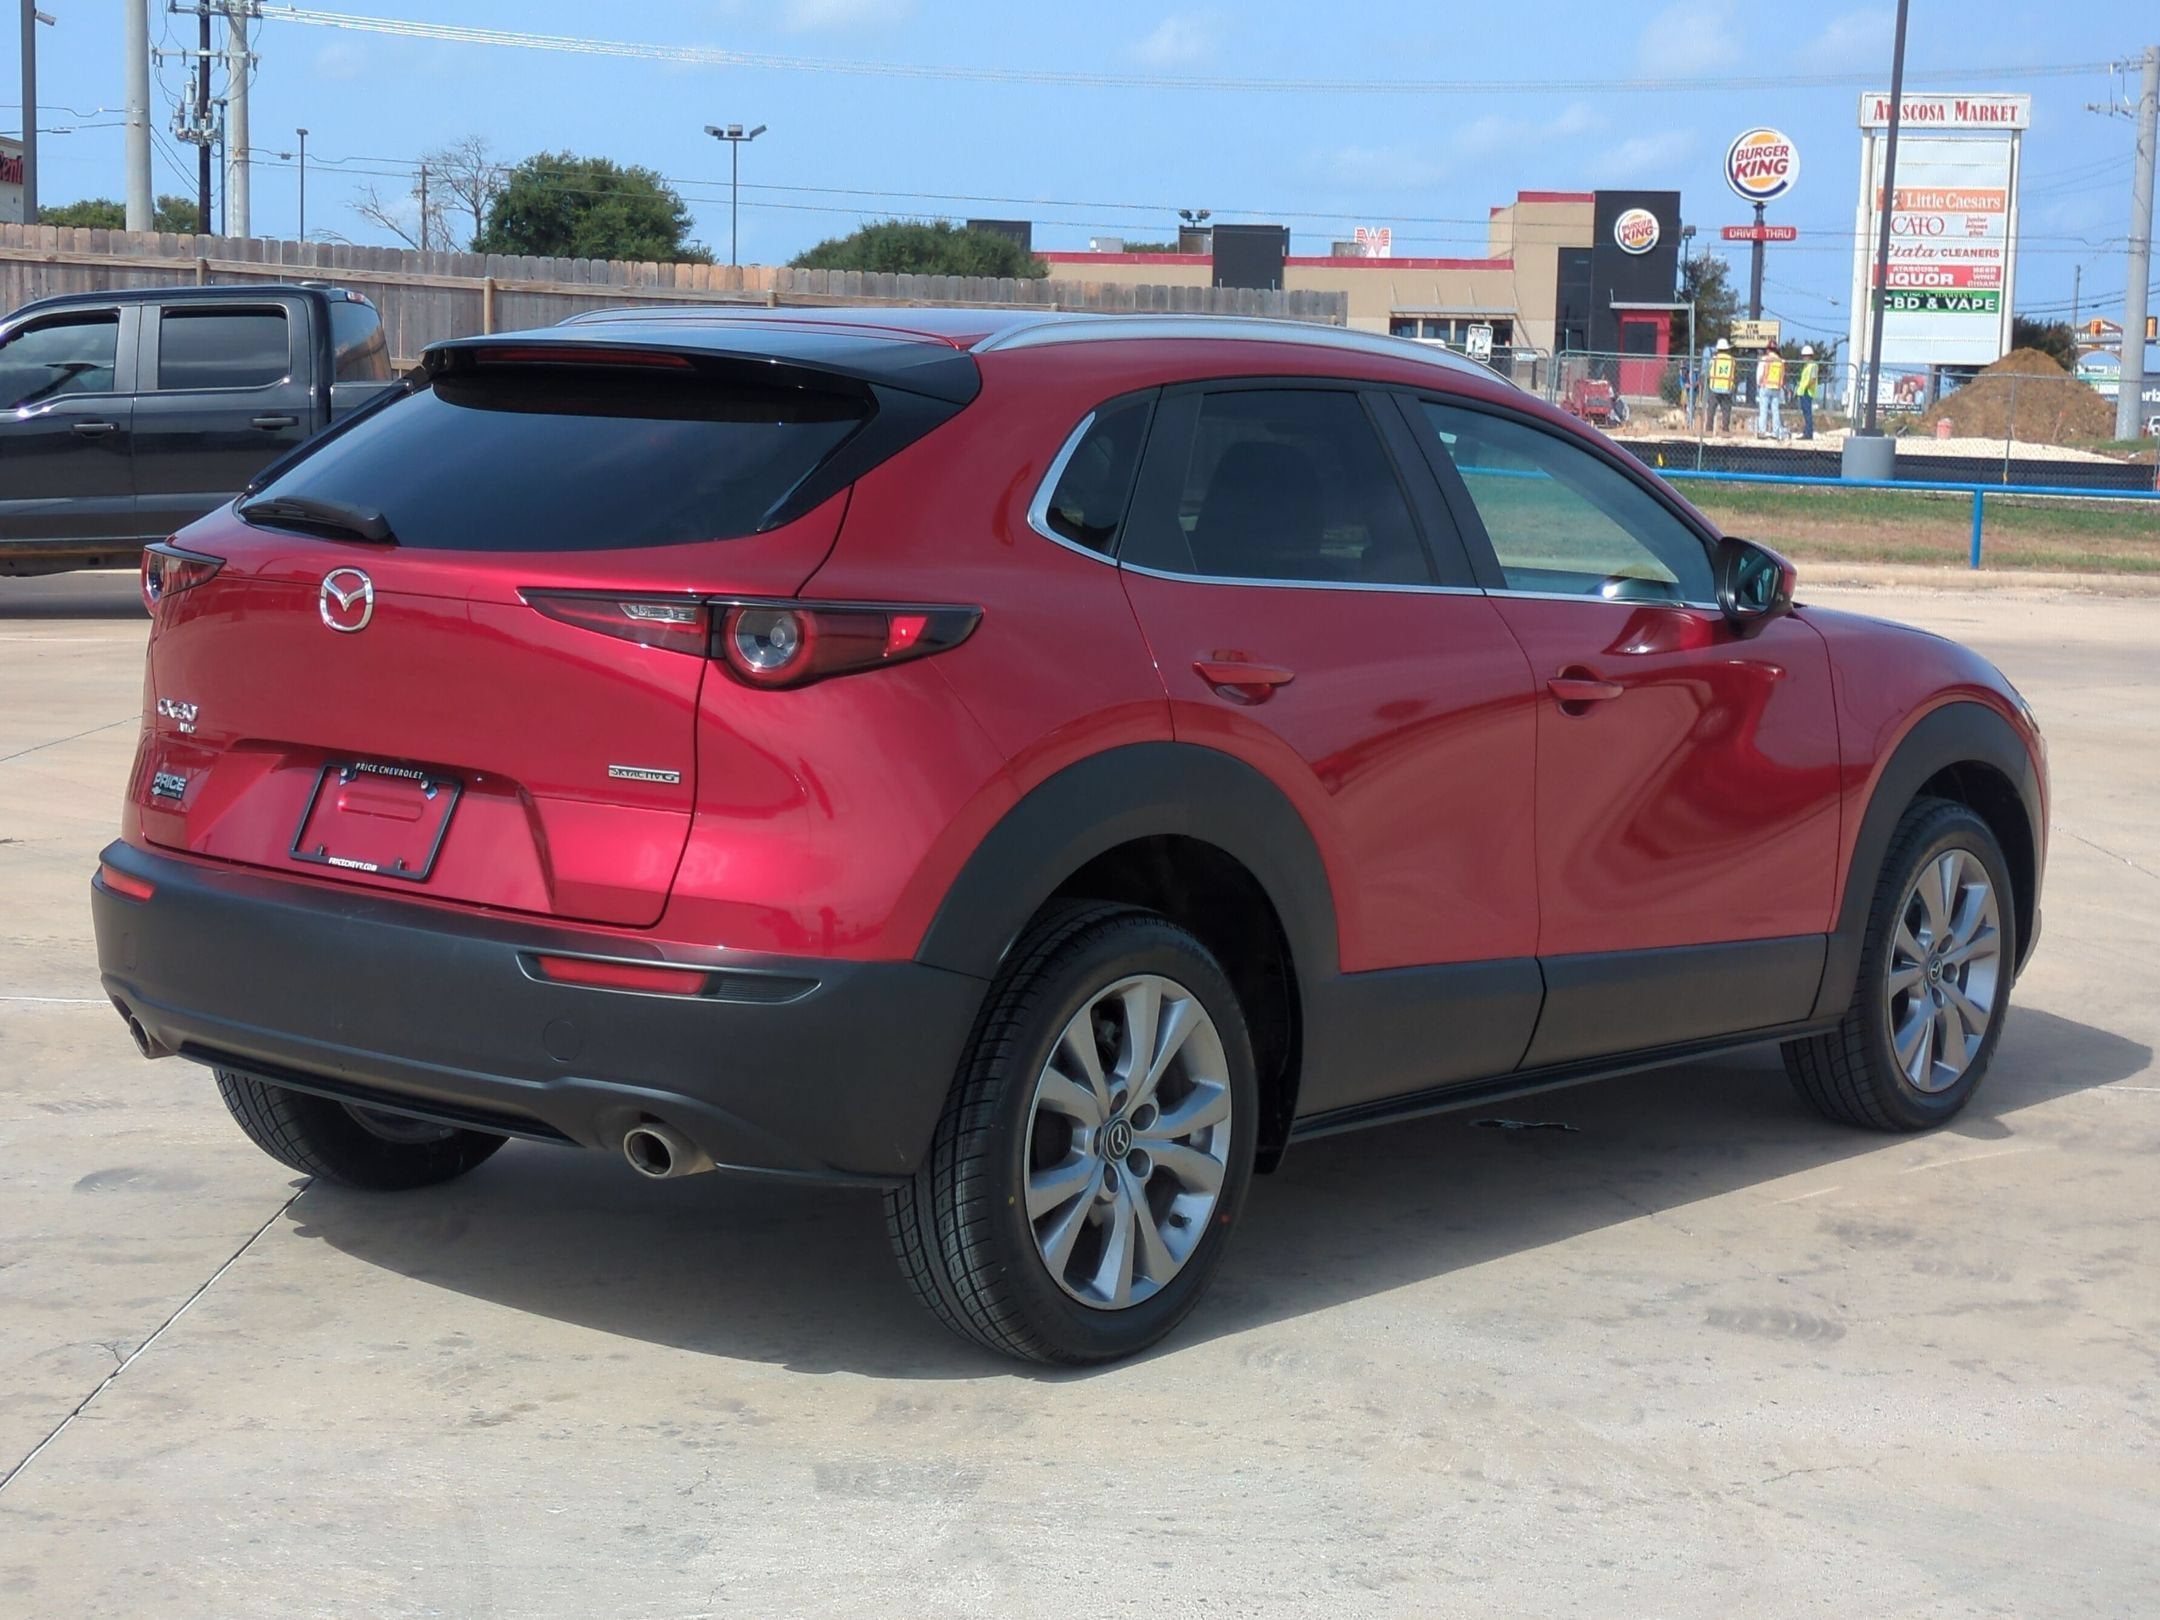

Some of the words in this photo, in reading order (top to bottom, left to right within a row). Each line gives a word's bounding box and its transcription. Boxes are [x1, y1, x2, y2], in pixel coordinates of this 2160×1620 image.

[1873, 99, 1945, 121] ATSCOSA
[1955, 101, 2018, 122] MARKET
[1736, 145, 1789, 162] BURGER
[1734, 158, 1789, 180] KING
[1907, 192, 1944, 209] Little
[1945, 193, 2000, 210] Caesars
[1623, 226, 1654, 243] KING
[1729, 228, 1758, 238] DRIVE
[1764, 229, 1791, 239] THRU
[1892, 216, 1945, 236] CATO
[1941, 249, 2000, 258] CLEANERS
[1886, 272, 1954, 285] IQUOR
[1884, 297, 1920, 309] CBD
[1926, 298, 1938, 310] &
[1945, 299, 1996, 311] VAPE
[355, 762, 378, 773] PRICE
[379, 766, 424, 780] CHEVROLET
[152, 771, 187, 791] PRICE
